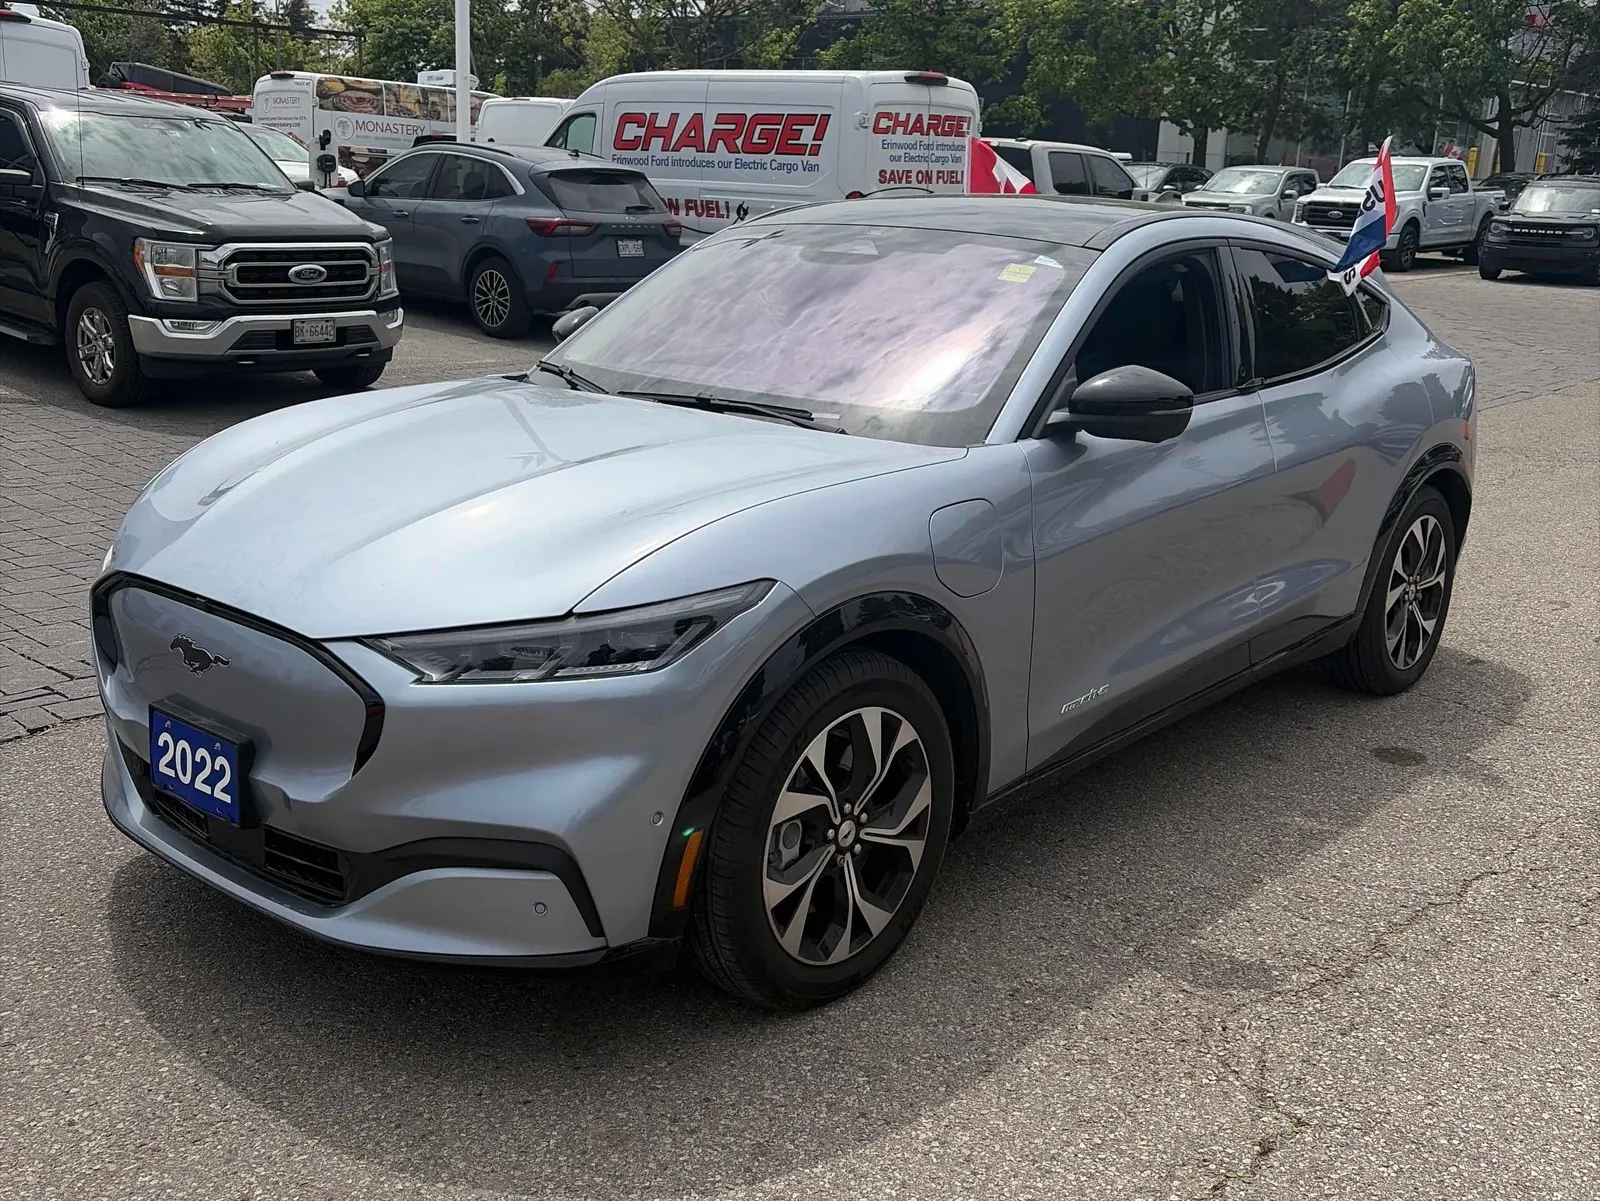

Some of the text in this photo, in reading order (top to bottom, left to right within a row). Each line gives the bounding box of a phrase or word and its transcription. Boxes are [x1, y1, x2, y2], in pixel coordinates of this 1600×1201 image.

[272, 96, 300, 104] MONASTERY
[355, 120, 426, 136] MONASTERY
[872, 112, 972, 137] CHARGE!
[613, 112, 831, 156] CHARGE!
[881, 139, 966, 152] Erinwood Ford introduces
[651, 155, 669, 167] Ford
[671, 156, 715, 169] introduces
[717, 160, 732, 169] our
[735, 158, 768, 171] Electric
[770, 159, 798, 174] Cargo
[801, 160, 819, 173] Van
[889, 153, 962, 165] our Electric Cargo Van
[878, 169, 912, 185] SAVE
[916, 170, 933, 185] ON
[685, 199, 730, 219] FUEL!
[301, 269, 319, 279] Ford
[295, 325, 334, 338] BK 66442
[158, 732, 231, 804] 2022
